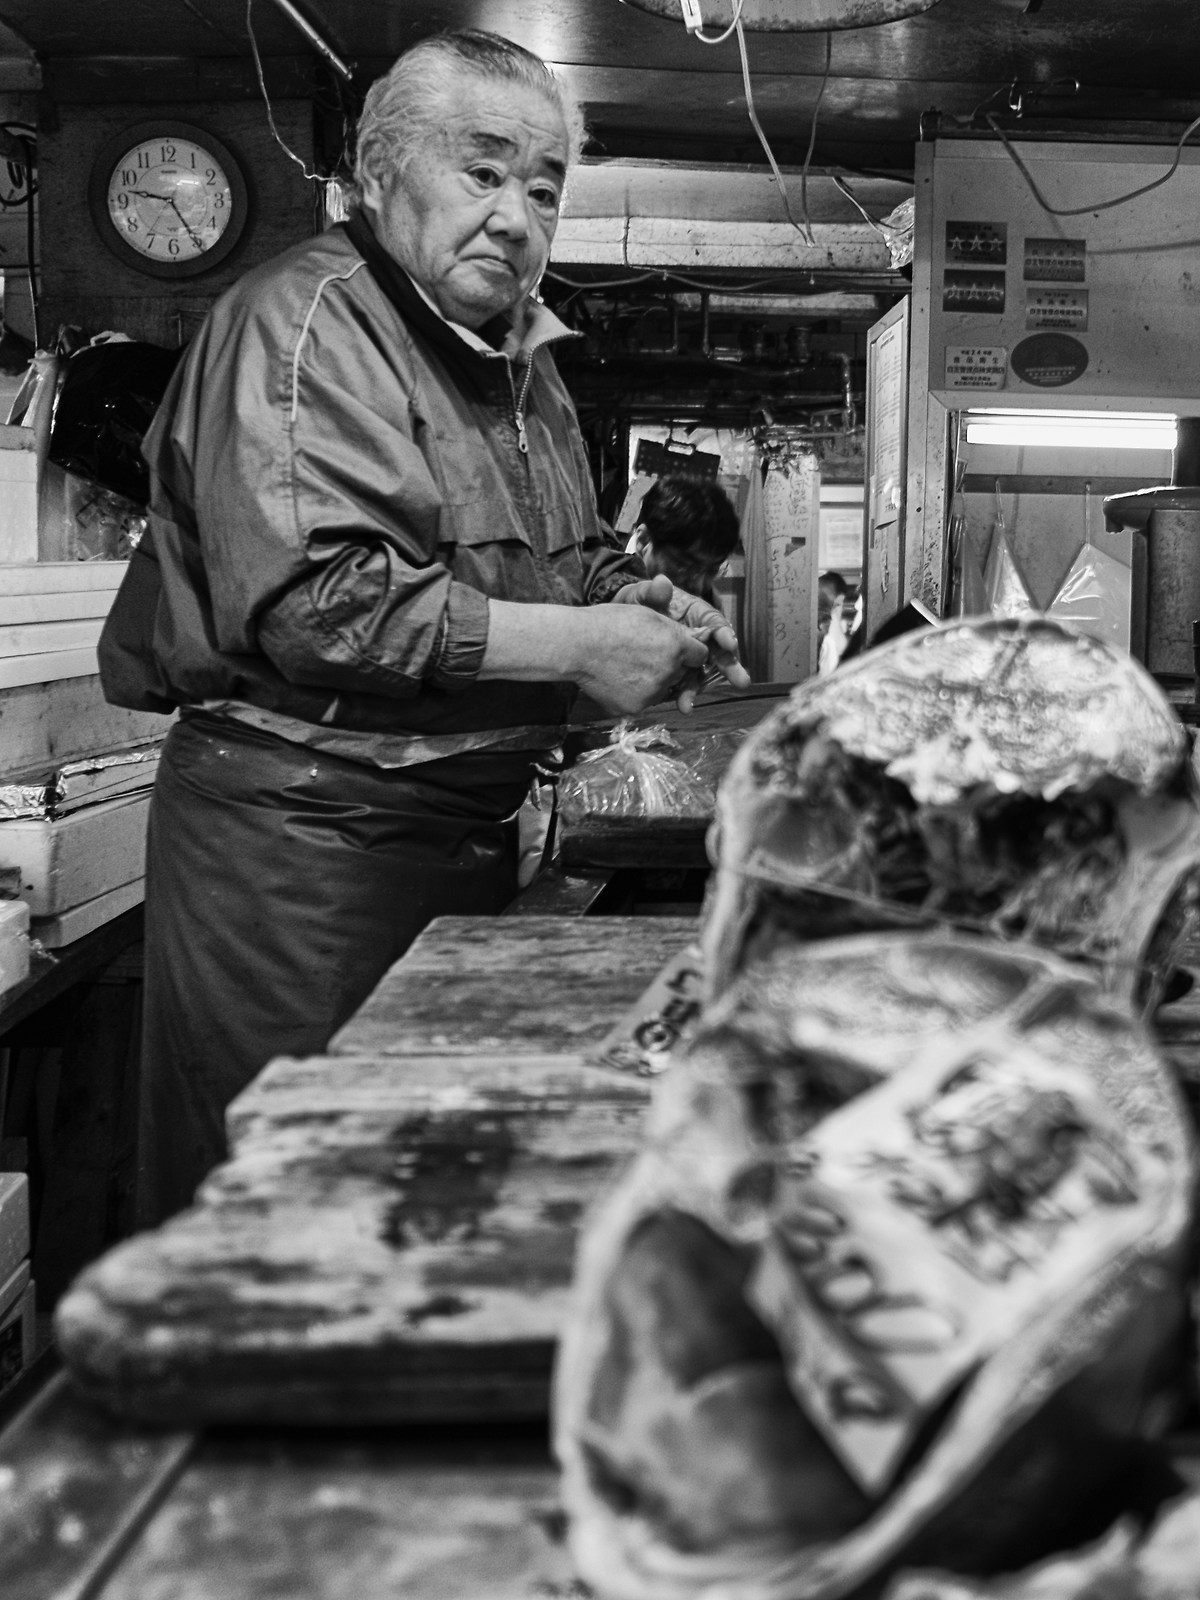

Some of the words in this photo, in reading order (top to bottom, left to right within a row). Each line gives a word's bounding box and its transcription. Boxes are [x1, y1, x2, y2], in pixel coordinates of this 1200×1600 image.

[138, 152, 150, 168] 11
[161, 145, 176, 163] 12
[190, 153, 196, 168] 1
[122, 170, 137, 186] 10
[205, 168, 216, 186] 2
[117, 193, 129, 210] 9
[214, 192, 224, 209] 3
[127, 217, 138, 232] 8
[207, 216, 216, 230] 4
[146, 233, 156, 249] 7
[168, 239, 180, 255] 6
